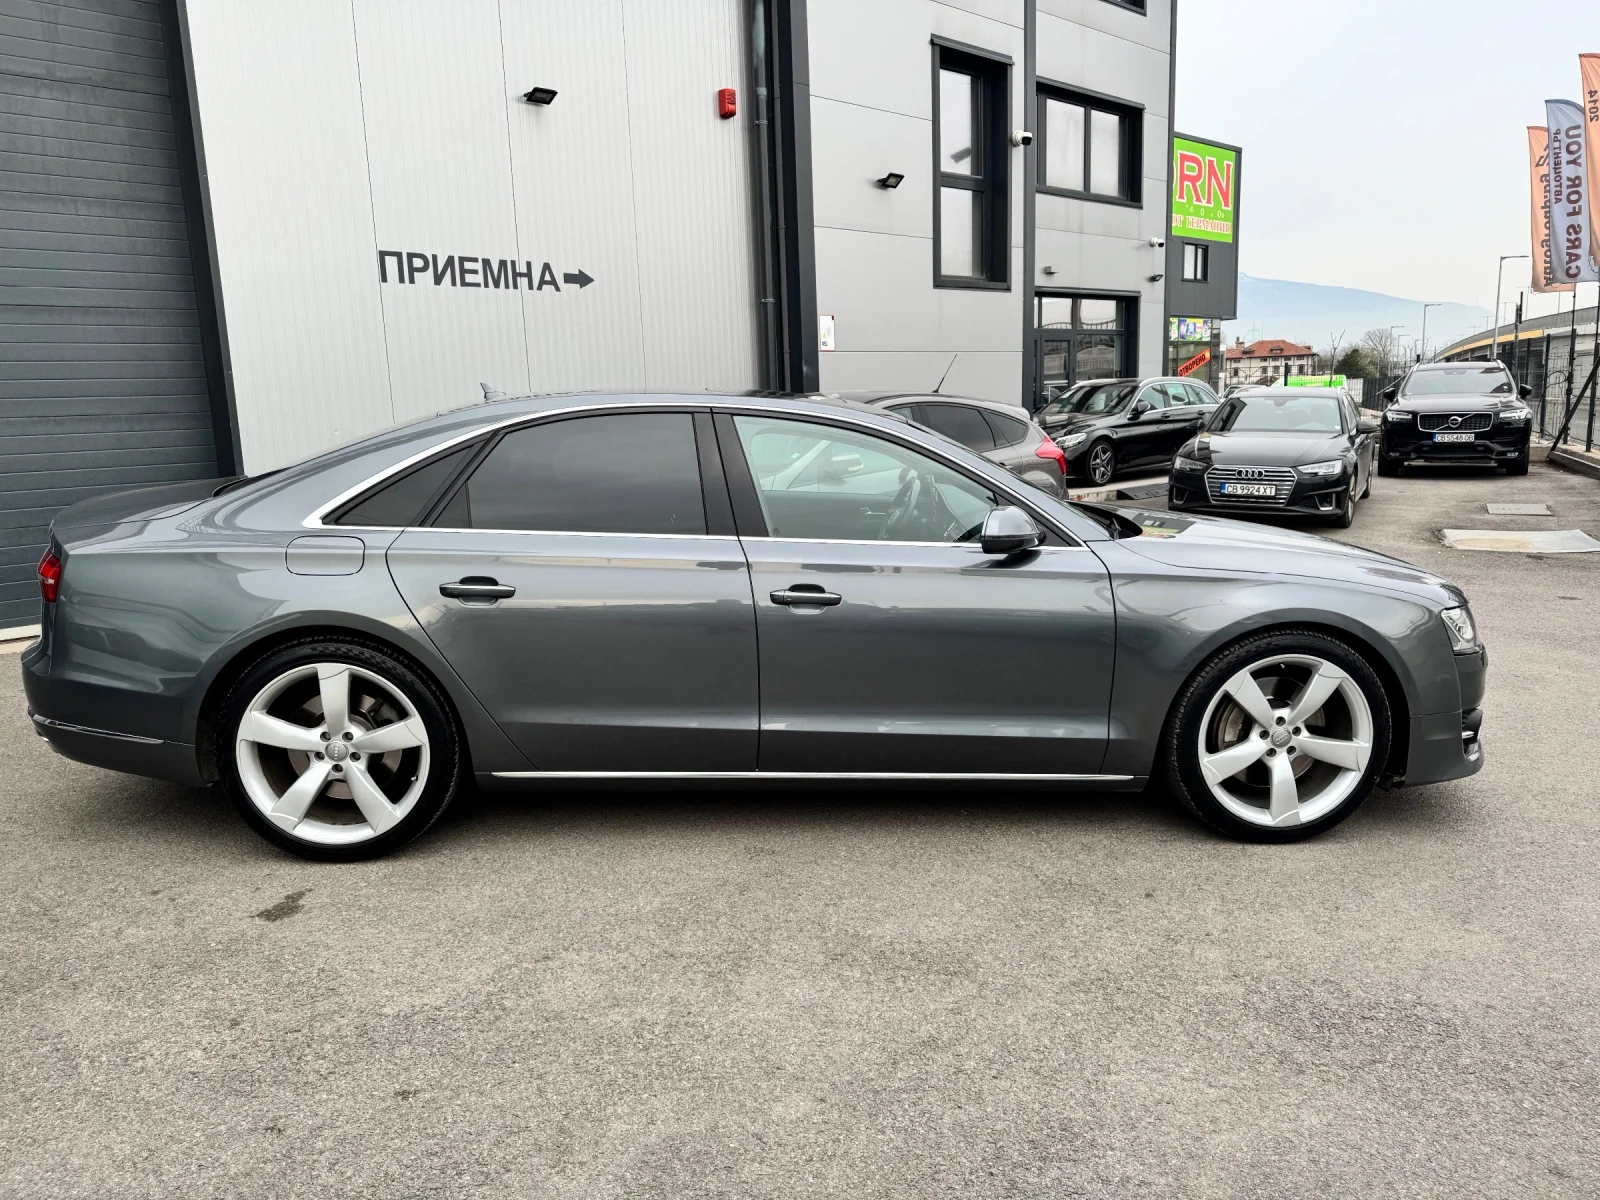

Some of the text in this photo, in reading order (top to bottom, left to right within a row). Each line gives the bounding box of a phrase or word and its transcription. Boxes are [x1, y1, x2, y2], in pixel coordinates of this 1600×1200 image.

[1173, 150, 1233, 210] RN
[378, 250, 561, 292] ПРИЕМНА
[1179, 353, 1206, 377] ОТВОРЕНО
[1226, 485, 1274, 495] CB 9924 XT
